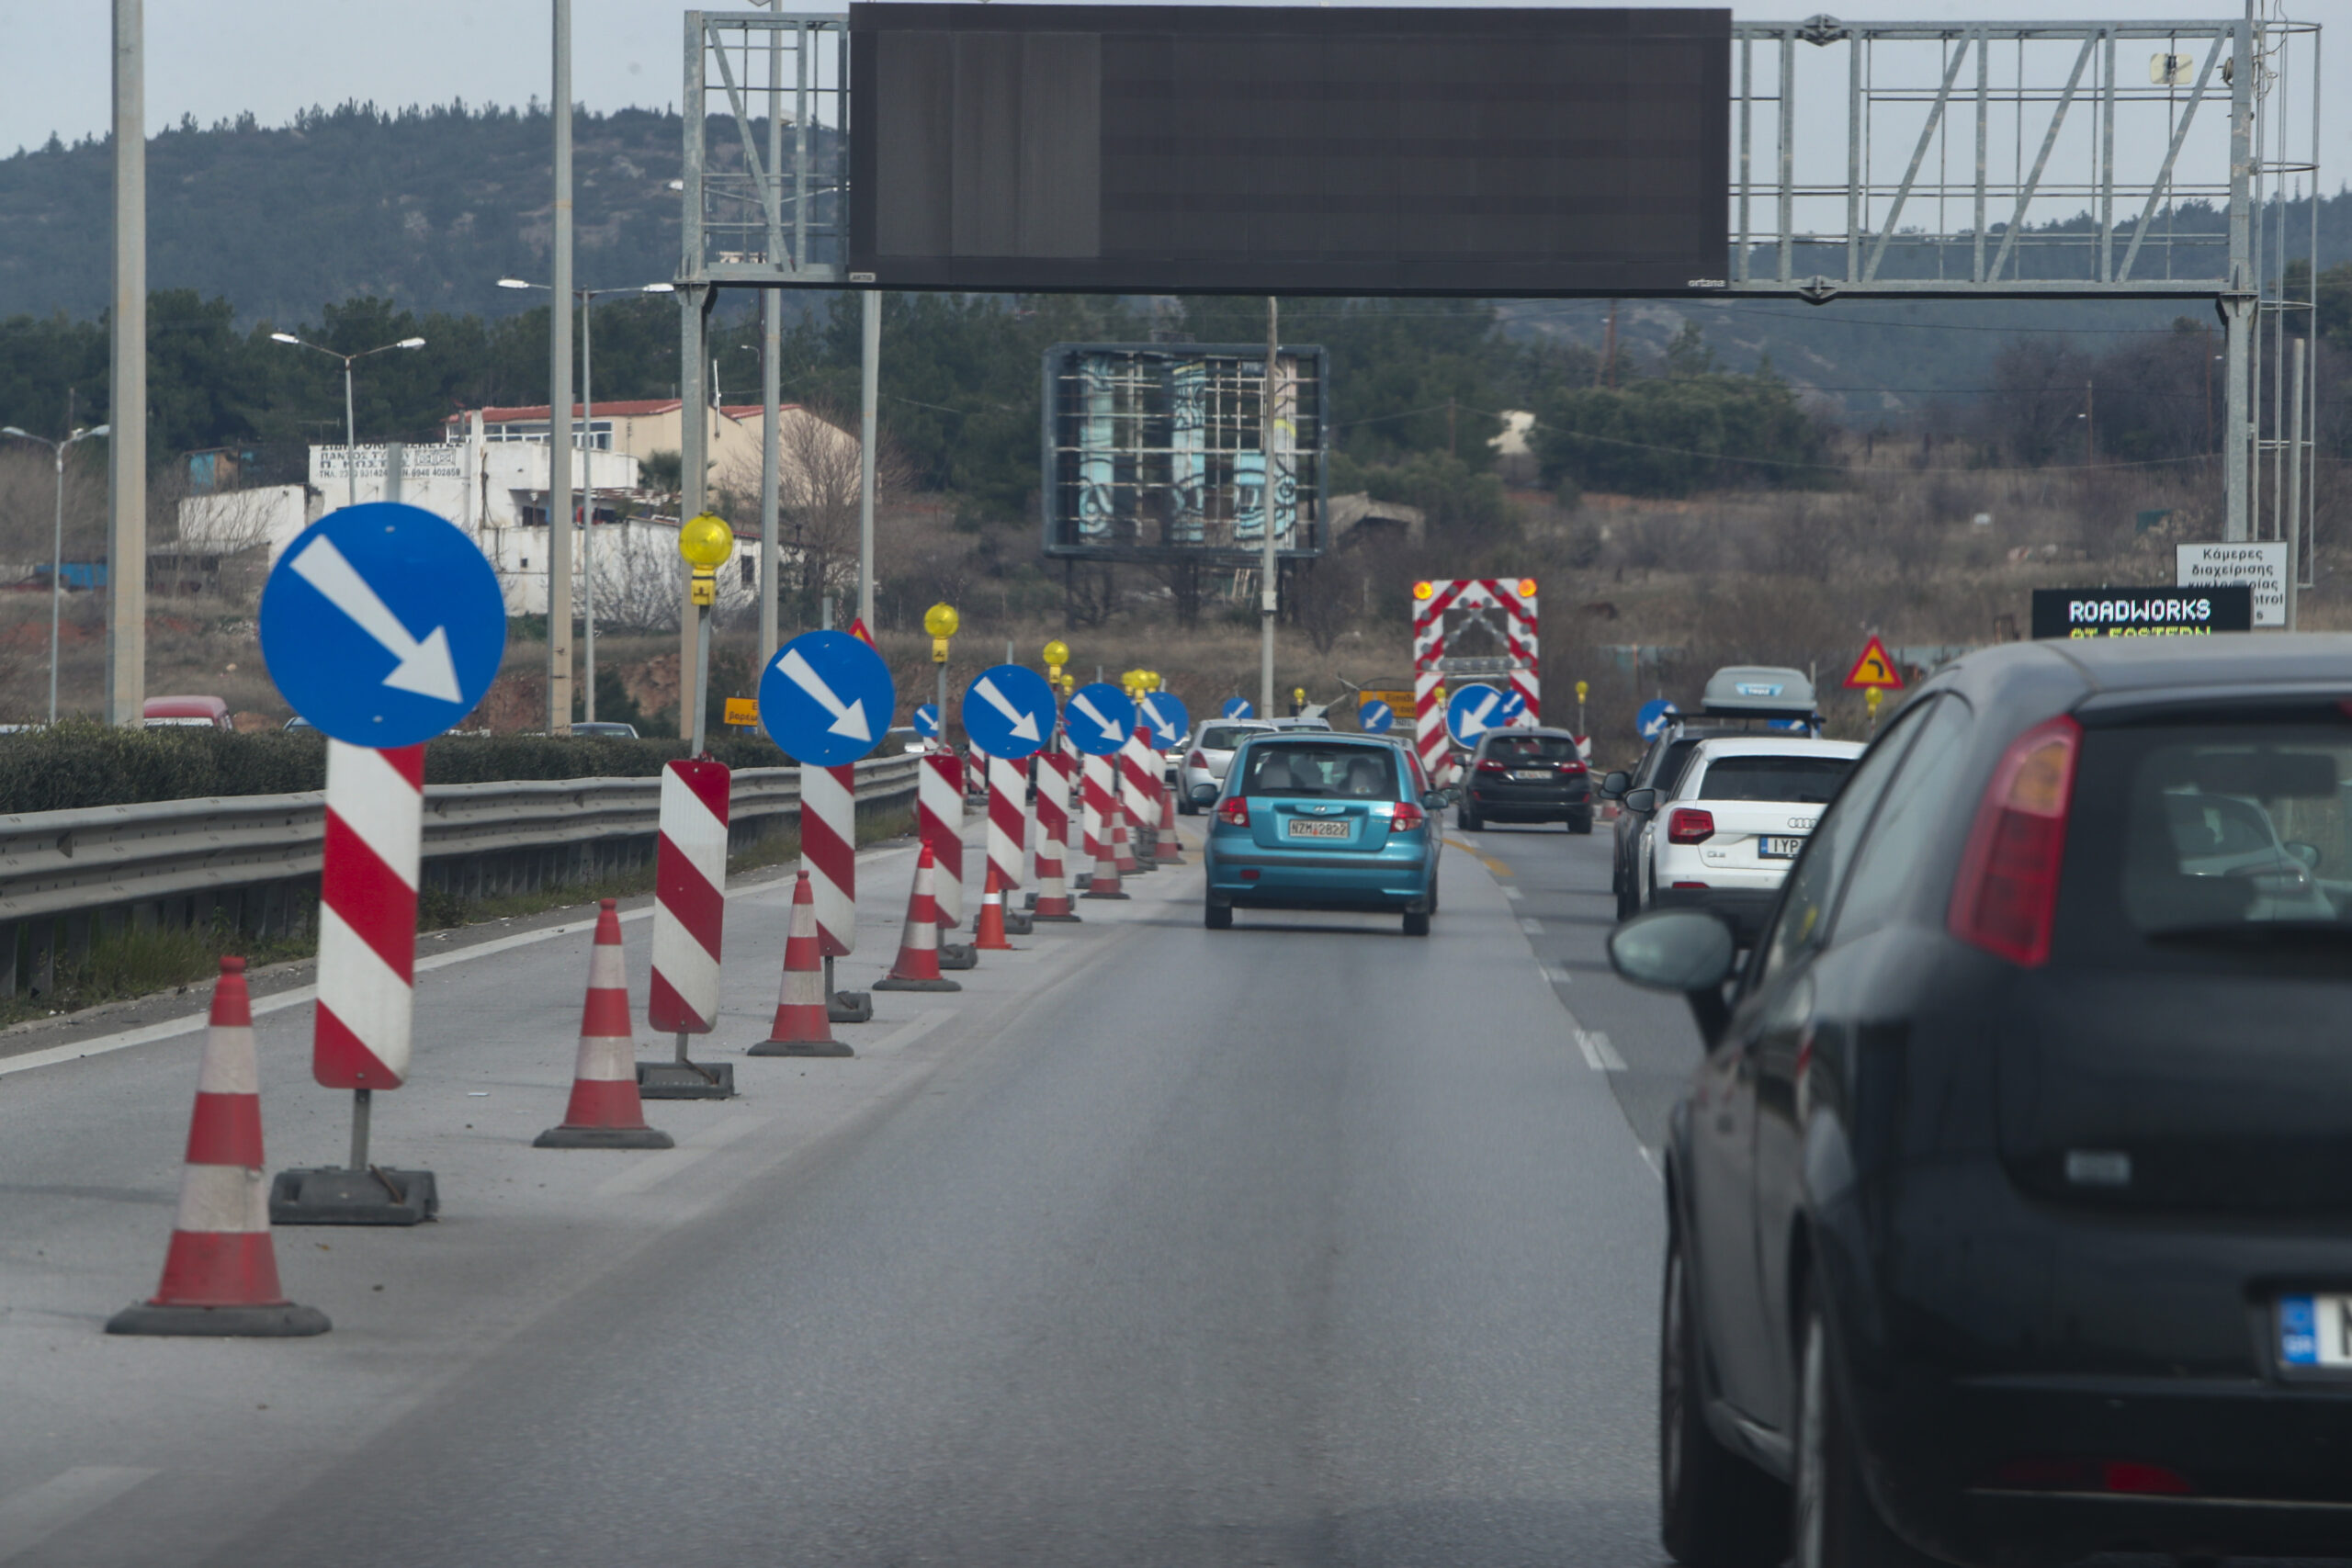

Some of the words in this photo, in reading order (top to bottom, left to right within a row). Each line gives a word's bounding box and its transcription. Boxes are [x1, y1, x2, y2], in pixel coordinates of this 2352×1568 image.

[2203, 548, 2264, 562] Κάμερες
[2191, 563, 2274, 578] διαχείρισης
[2069, 599, 2211, 622] ROADWORKS
[1318, 823, 1347, 836] 2822
